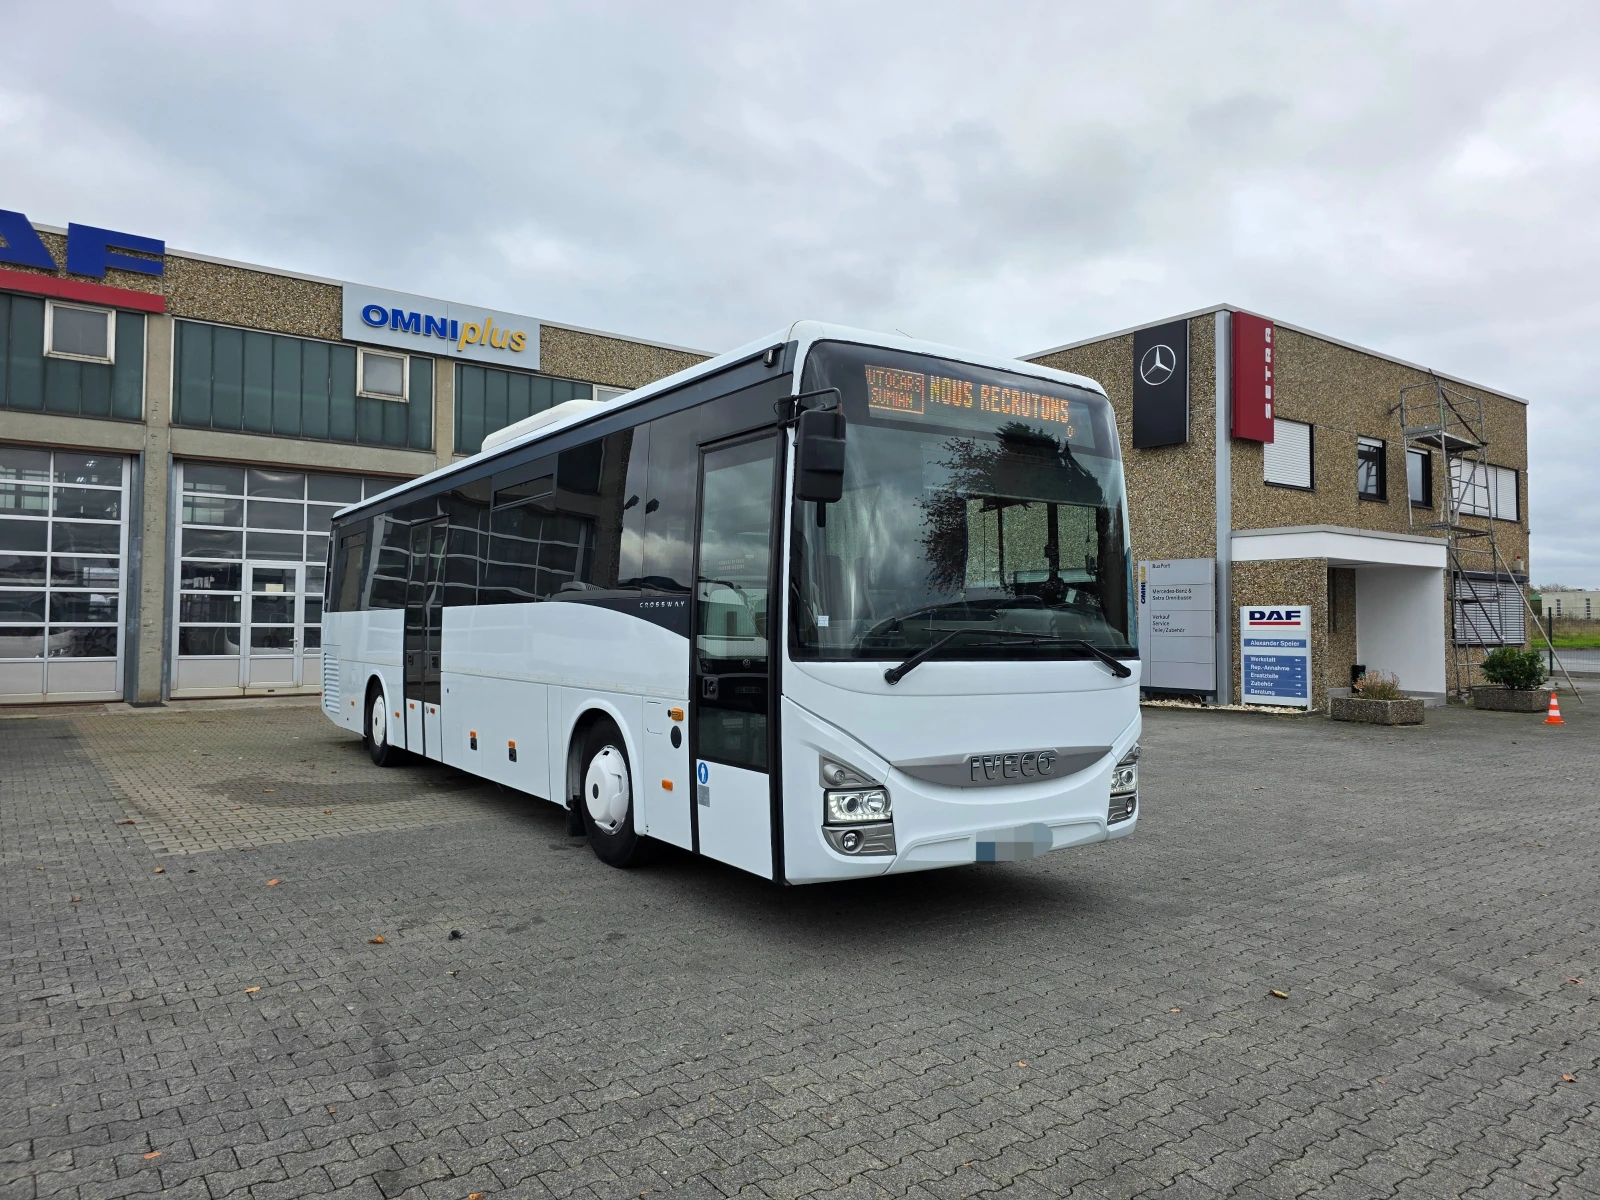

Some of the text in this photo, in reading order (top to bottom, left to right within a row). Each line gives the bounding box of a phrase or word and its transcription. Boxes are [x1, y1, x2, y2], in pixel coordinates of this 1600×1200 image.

[361, 304, 527, 352] OMNIplus
[930, 375, 1069, 423] NOUS RECRUTONS
[639, 600, 685, 608] CROSSWAY
[1249, 610, 1301, 620] DAF
[970, 750, 1056, 782] IVECO
